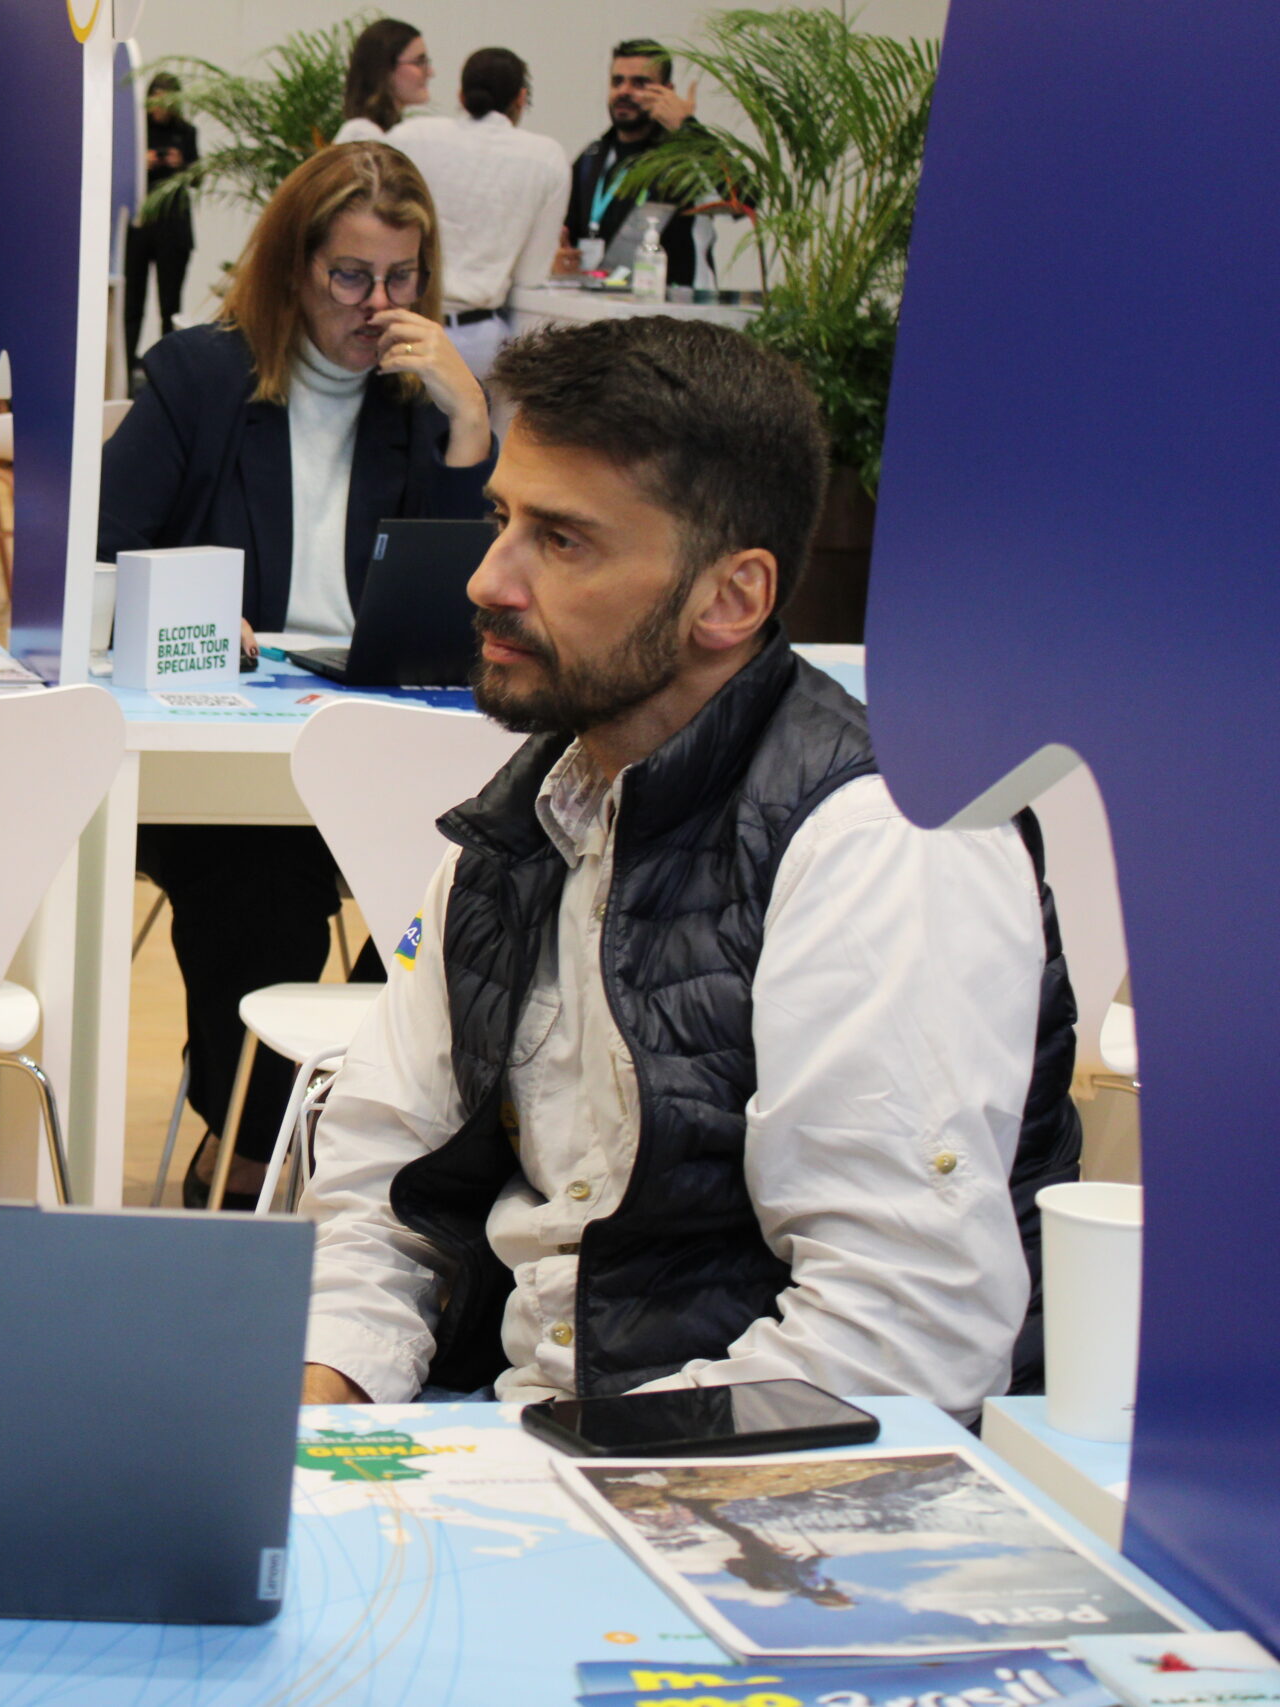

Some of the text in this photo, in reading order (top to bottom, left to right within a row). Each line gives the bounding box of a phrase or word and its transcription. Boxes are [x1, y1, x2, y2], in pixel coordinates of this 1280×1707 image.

[158, 624, 216, 642] ELCOTOUR
[158, 638, 229, 658] BRAZIL TOUR
[157, 655, 226, 675] SPECIALISTS
[306, 1444, 477, 1457] GERMANY
